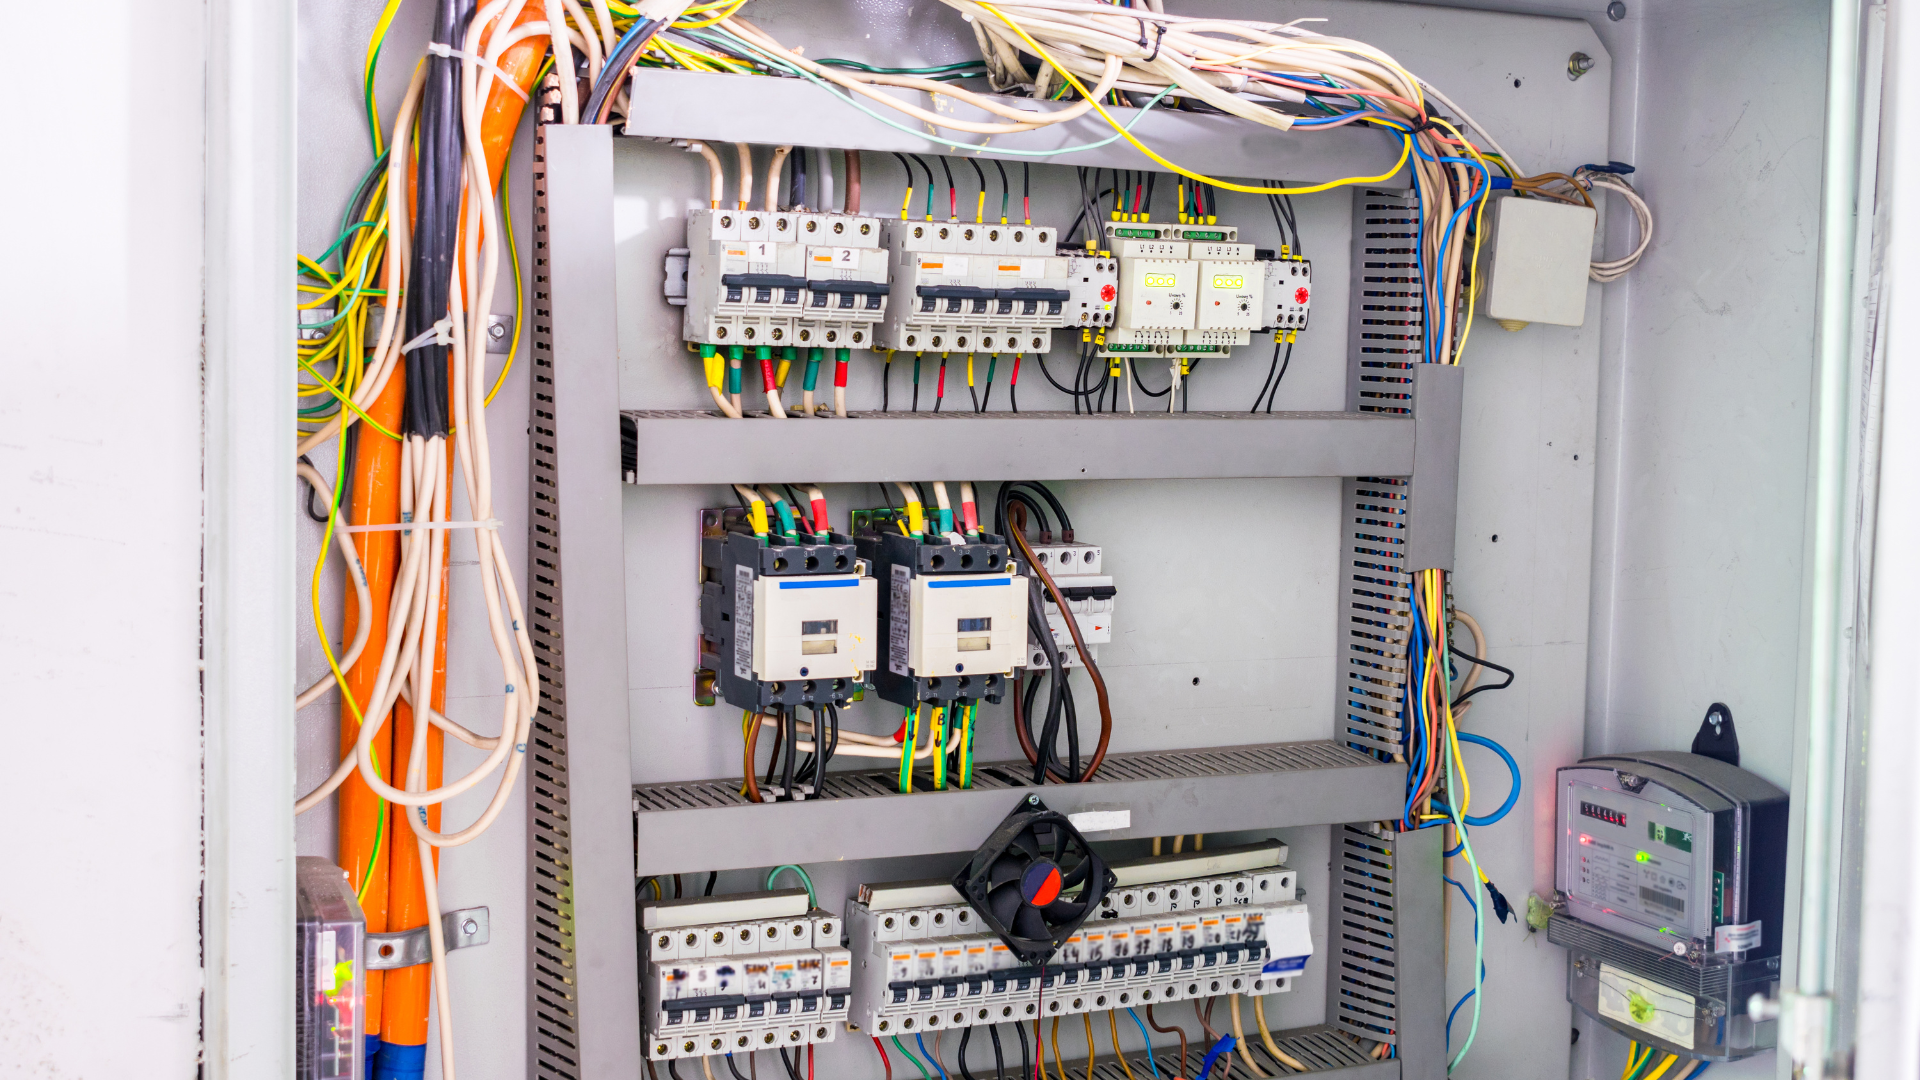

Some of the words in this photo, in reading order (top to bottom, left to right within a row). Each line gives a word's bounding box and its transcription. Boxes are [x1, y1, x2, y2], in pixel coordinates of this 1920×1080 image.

[759, 244, 765, 255] 1
[842, 250, 851, 261] 2
[938, 713, 946, 726] B
[1090, 943, 1103, 962] 15
